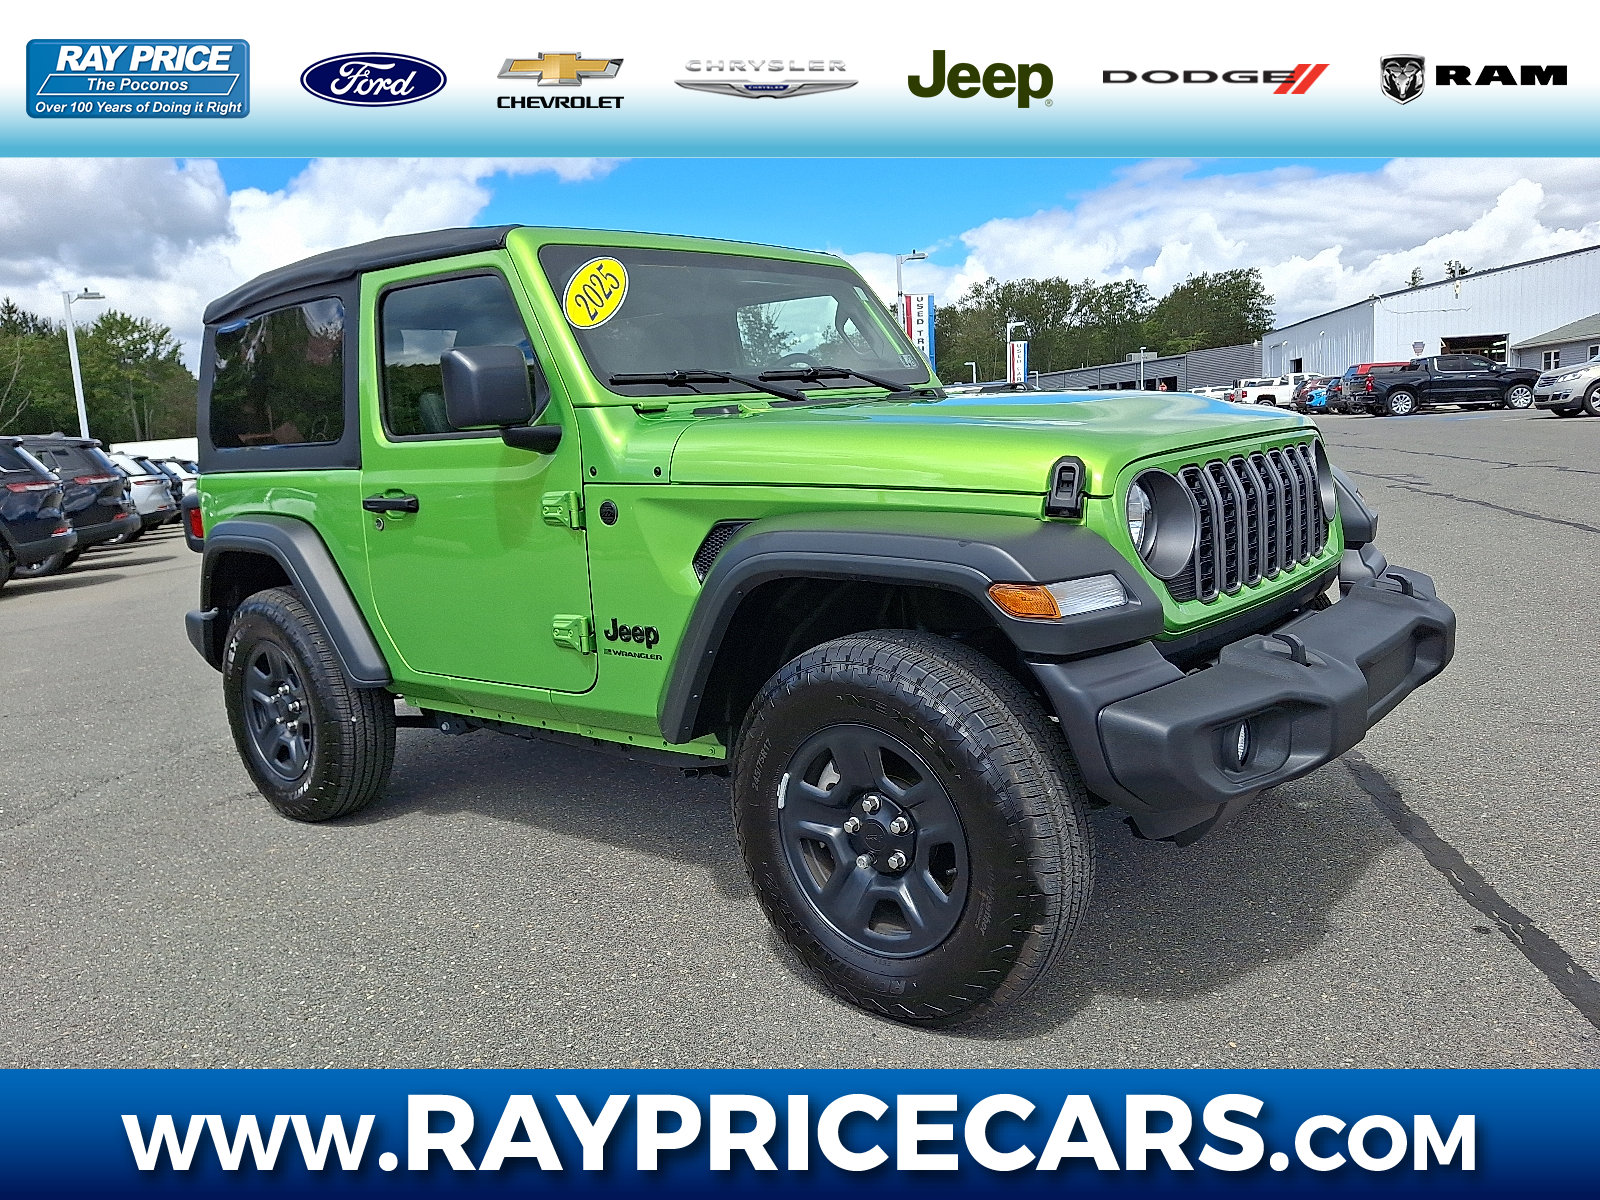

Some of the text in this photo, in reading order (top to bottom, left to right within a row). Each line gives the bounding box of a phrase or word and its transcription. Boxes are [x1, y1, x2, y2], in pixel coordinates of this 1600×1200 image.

[574, 263, 620, 321] 2025
[916, 296, 924, 325] USED
[604, 617, 660, 649] Jeep
[612, 649, 663, 661] WRANGLER
